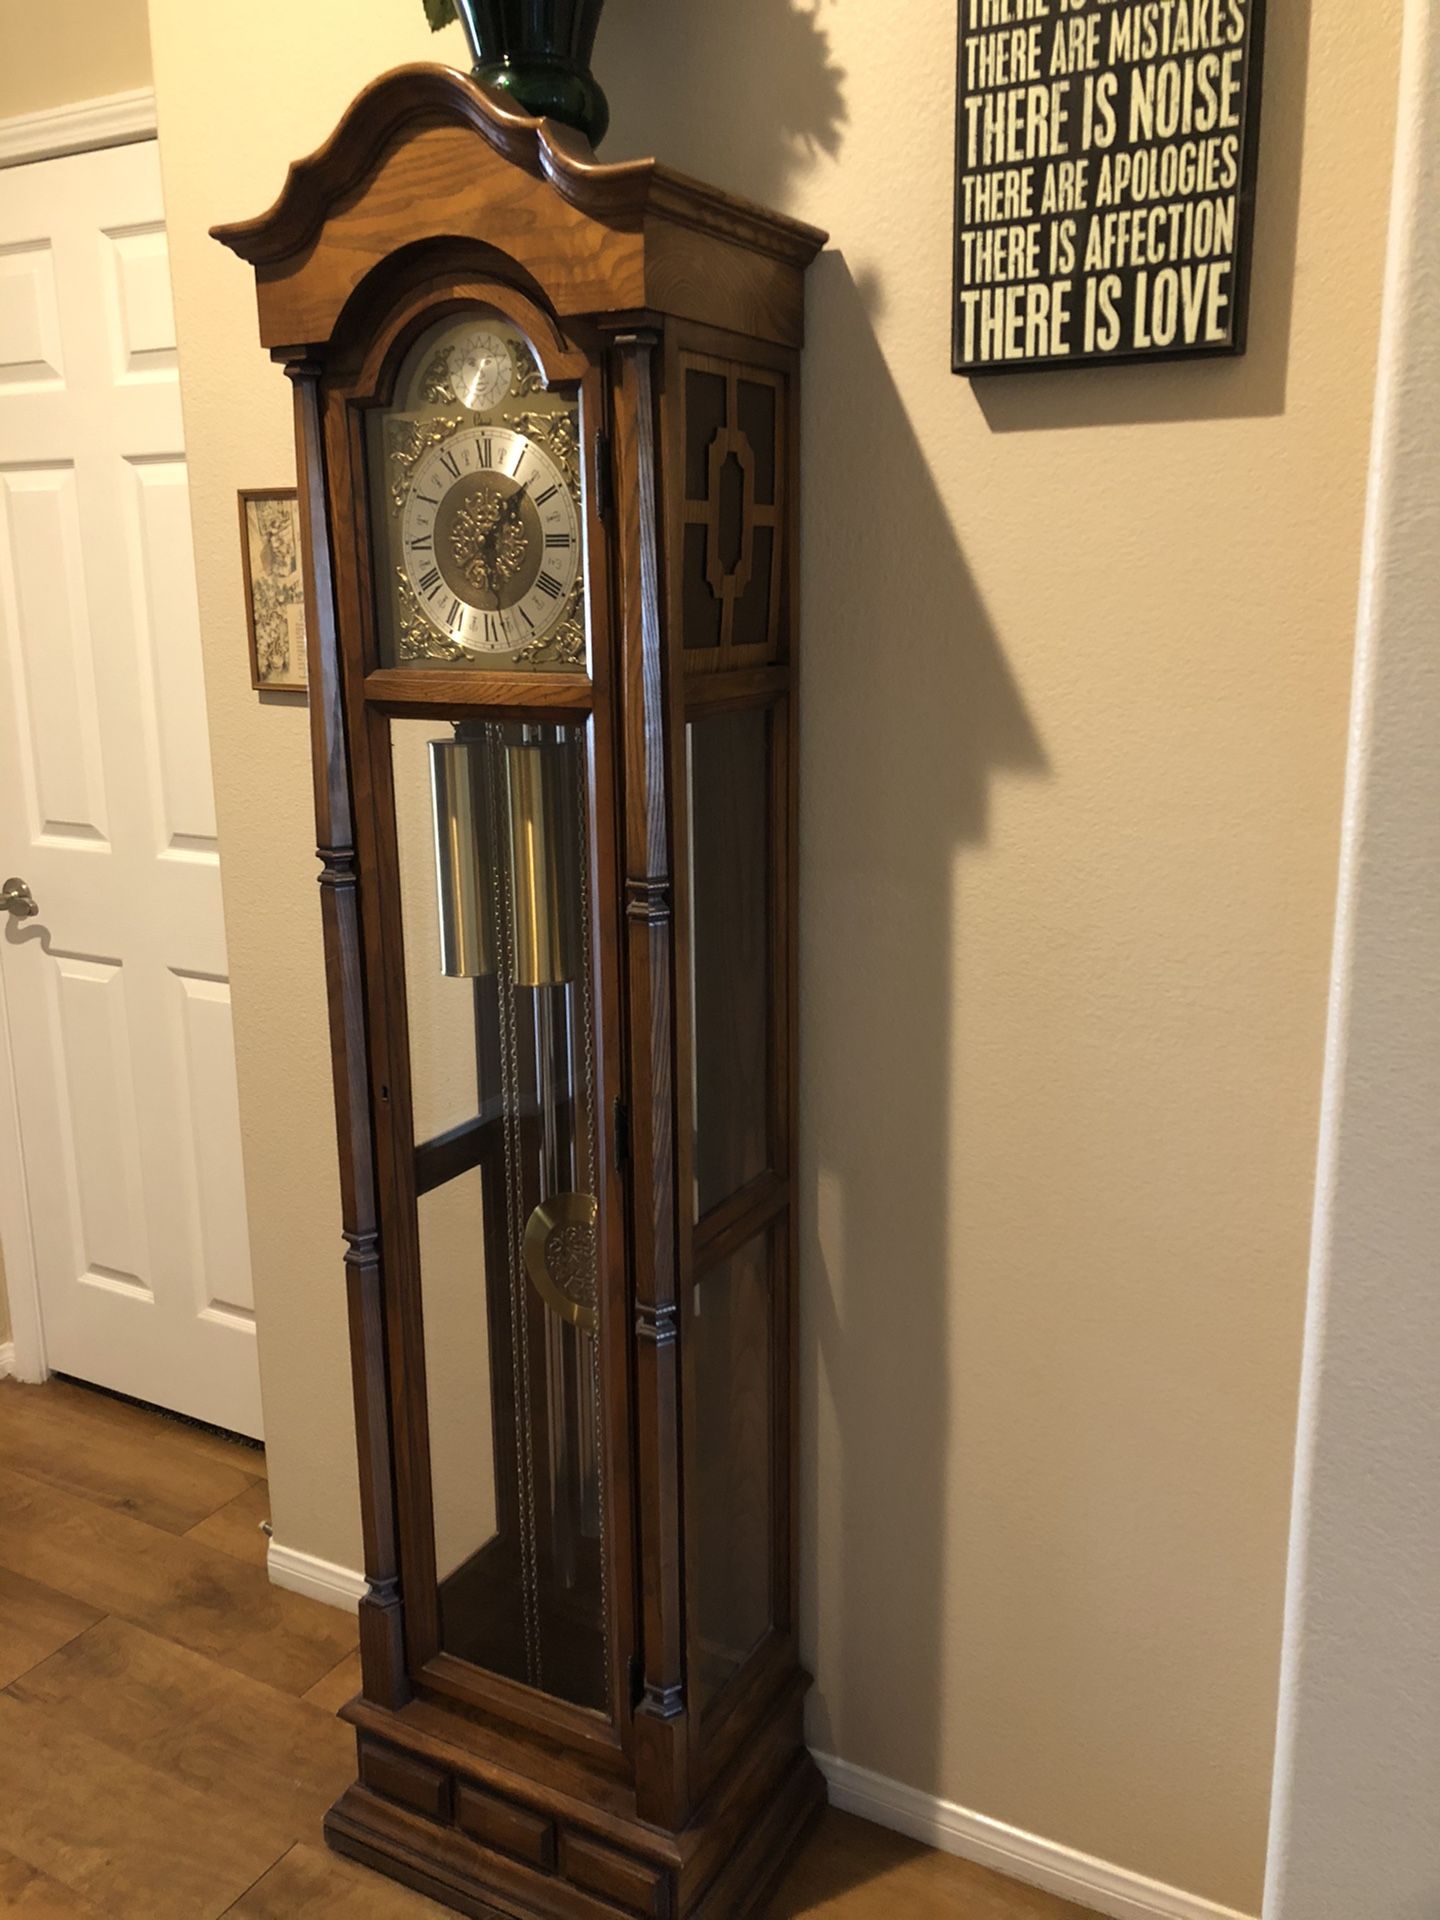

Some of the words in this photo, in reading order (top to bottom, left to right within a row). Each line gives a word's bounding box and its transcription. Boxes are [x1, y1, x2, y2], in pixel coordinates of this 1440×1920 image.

[965, 25, 1042, 91] THERE
[1050, 13, 1101, 77] ARE
[1108, 0, 1245, 66] MISTAKES
[965, 81, 1071, 169] THERE
[1082, 72, 1118, 151] IS
[1129, 49, 1243, 144] NOISE
[962, 167, 1035, 225] THERE
[1041, 159, 1089, 215] ARE
[1096, 135, 1239, 208] APOLOGIES
[961, 224, 1041, 285] THERE
[1050, 219, 1077, 275] IS
[1084, 196, 1236, 272] AFFECTION
[960, 280, 1072, 363] THERE
[1084, 275, 1122, 352] IS
[1134, 261, 1231, 349] LOVE
